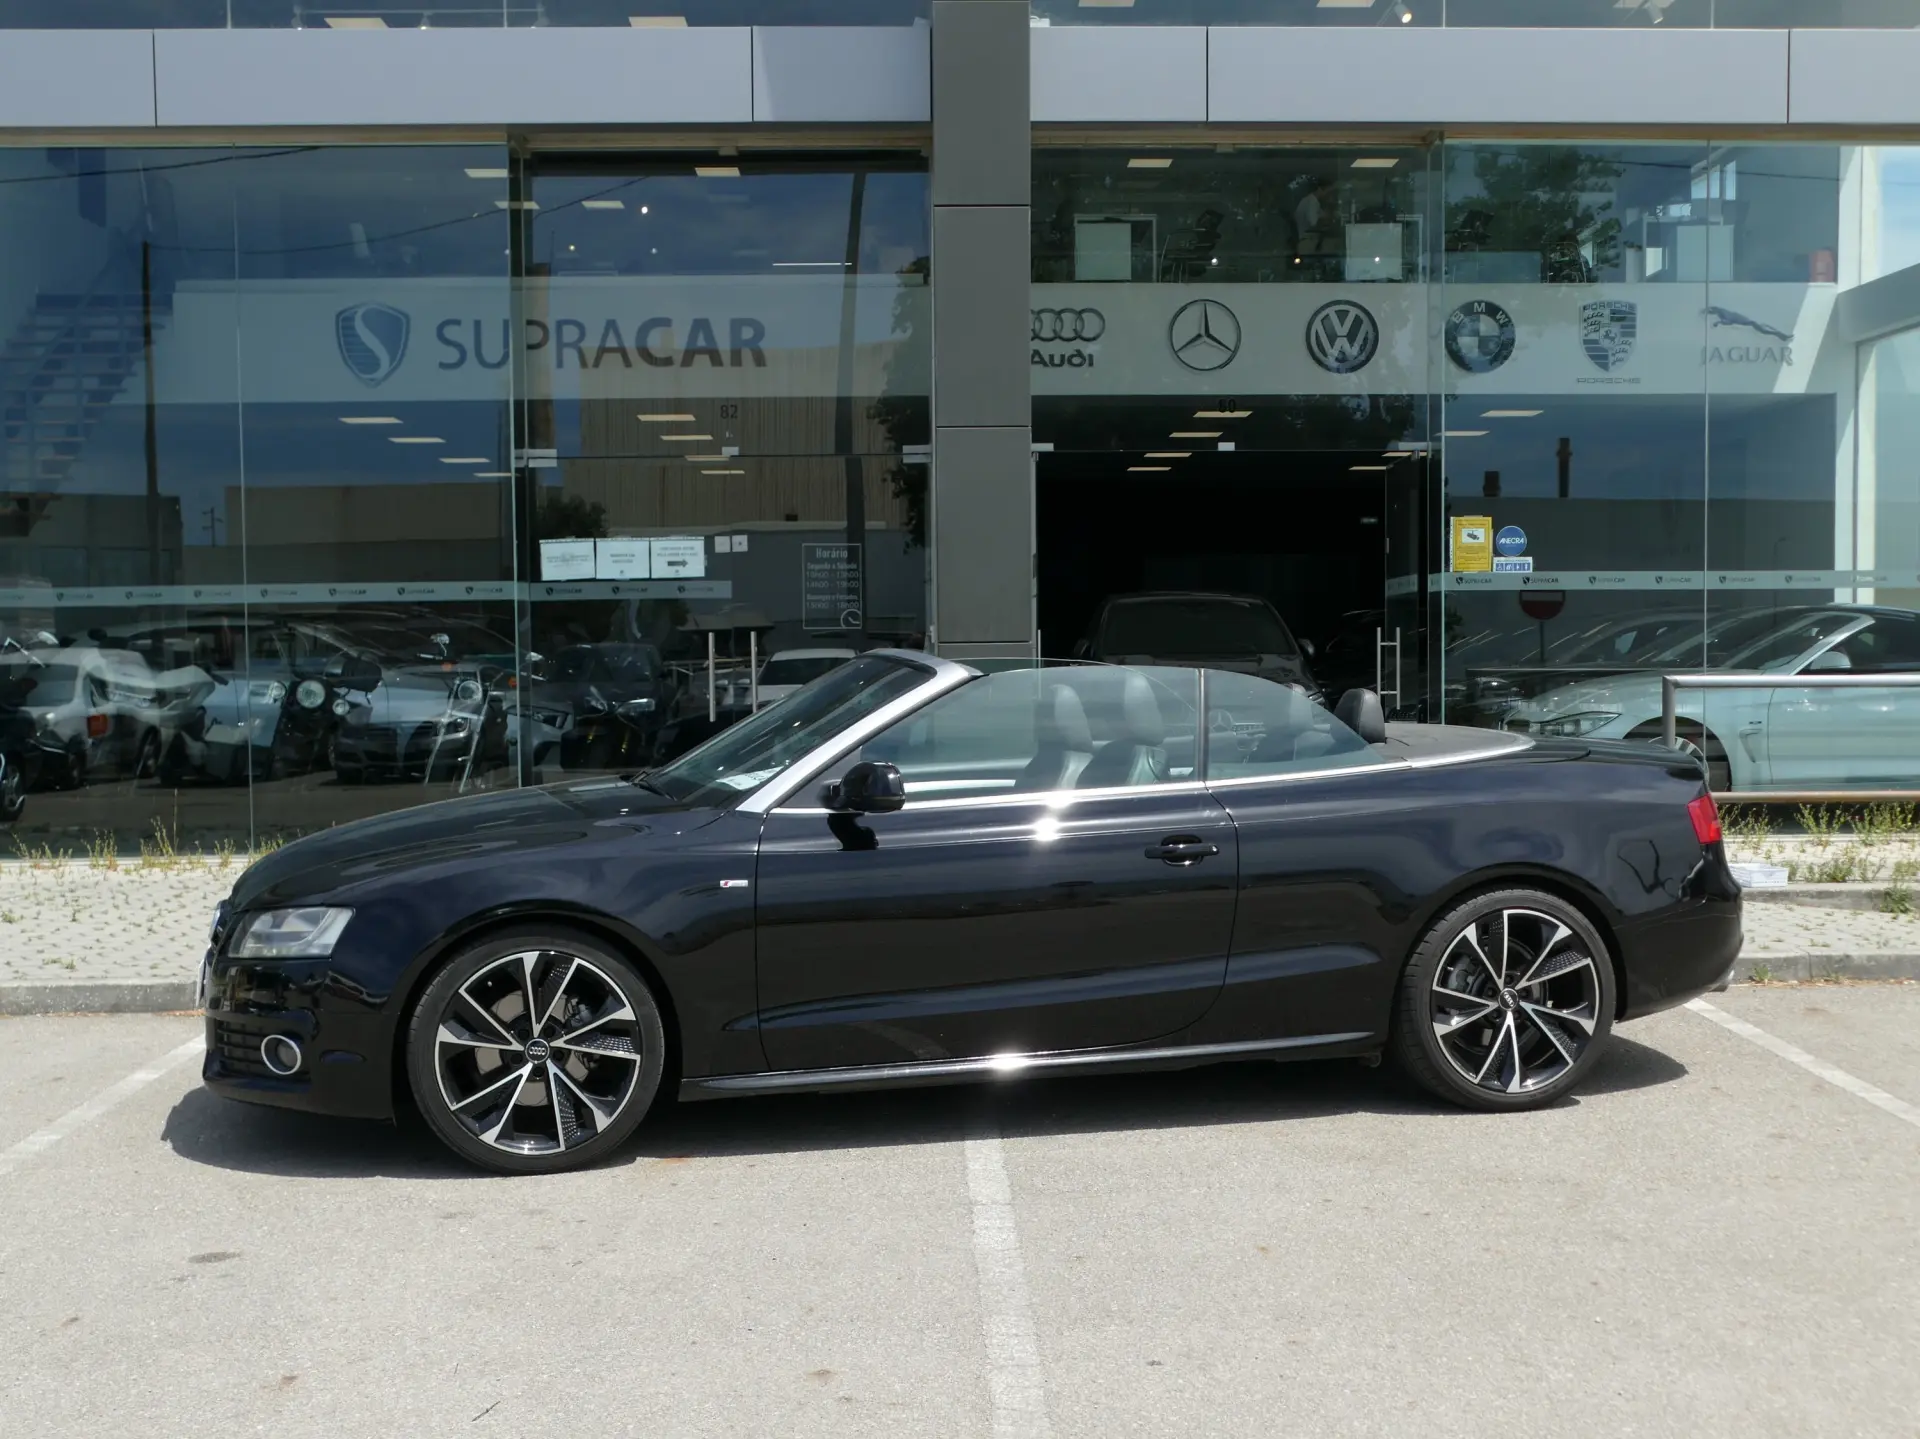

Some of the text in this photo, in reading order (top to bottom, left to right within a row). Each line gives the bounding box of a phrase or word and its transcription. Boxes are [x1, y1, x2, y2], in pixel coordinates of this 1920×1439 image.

[1452, 302, 1509, 324] BMW
[436, 317, 767, 370] SUPRACAR
[1031, 349, 1094, 368] Audi
[1700, 346, 1793, 366] JAGUAR
[1576, 377, 1642, 385] PORSCHE
[719, 404, 739, 420] 82
[1498, 537, 1525, 545] ANECRA
[816, 547, 848, 559] Horário
